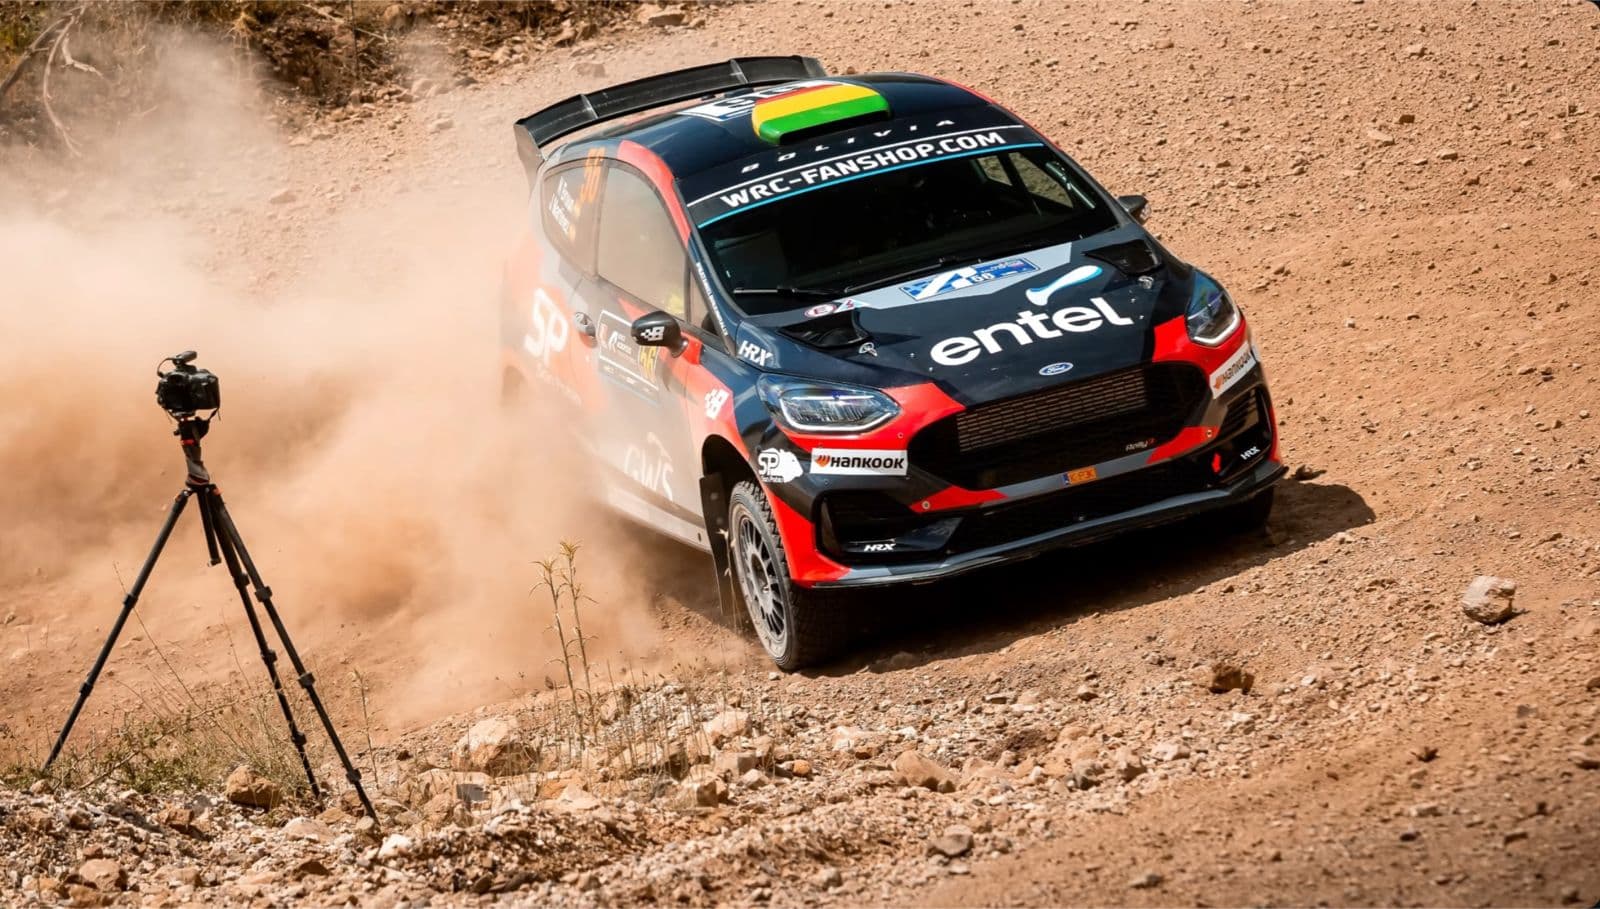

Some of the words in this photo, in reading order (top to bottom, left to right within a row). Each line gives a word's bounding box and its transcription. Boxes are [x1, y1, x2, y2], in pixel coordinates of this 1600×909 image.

[720, 131, 1006, 208] WRC-FANSHOP.COM
[741, 120, 955, 173] BOLIVIA
[739, 340, 774, 367] HRX
[930, 297, 1135, 366] entel
[863, 543, 897, 552] HRX
